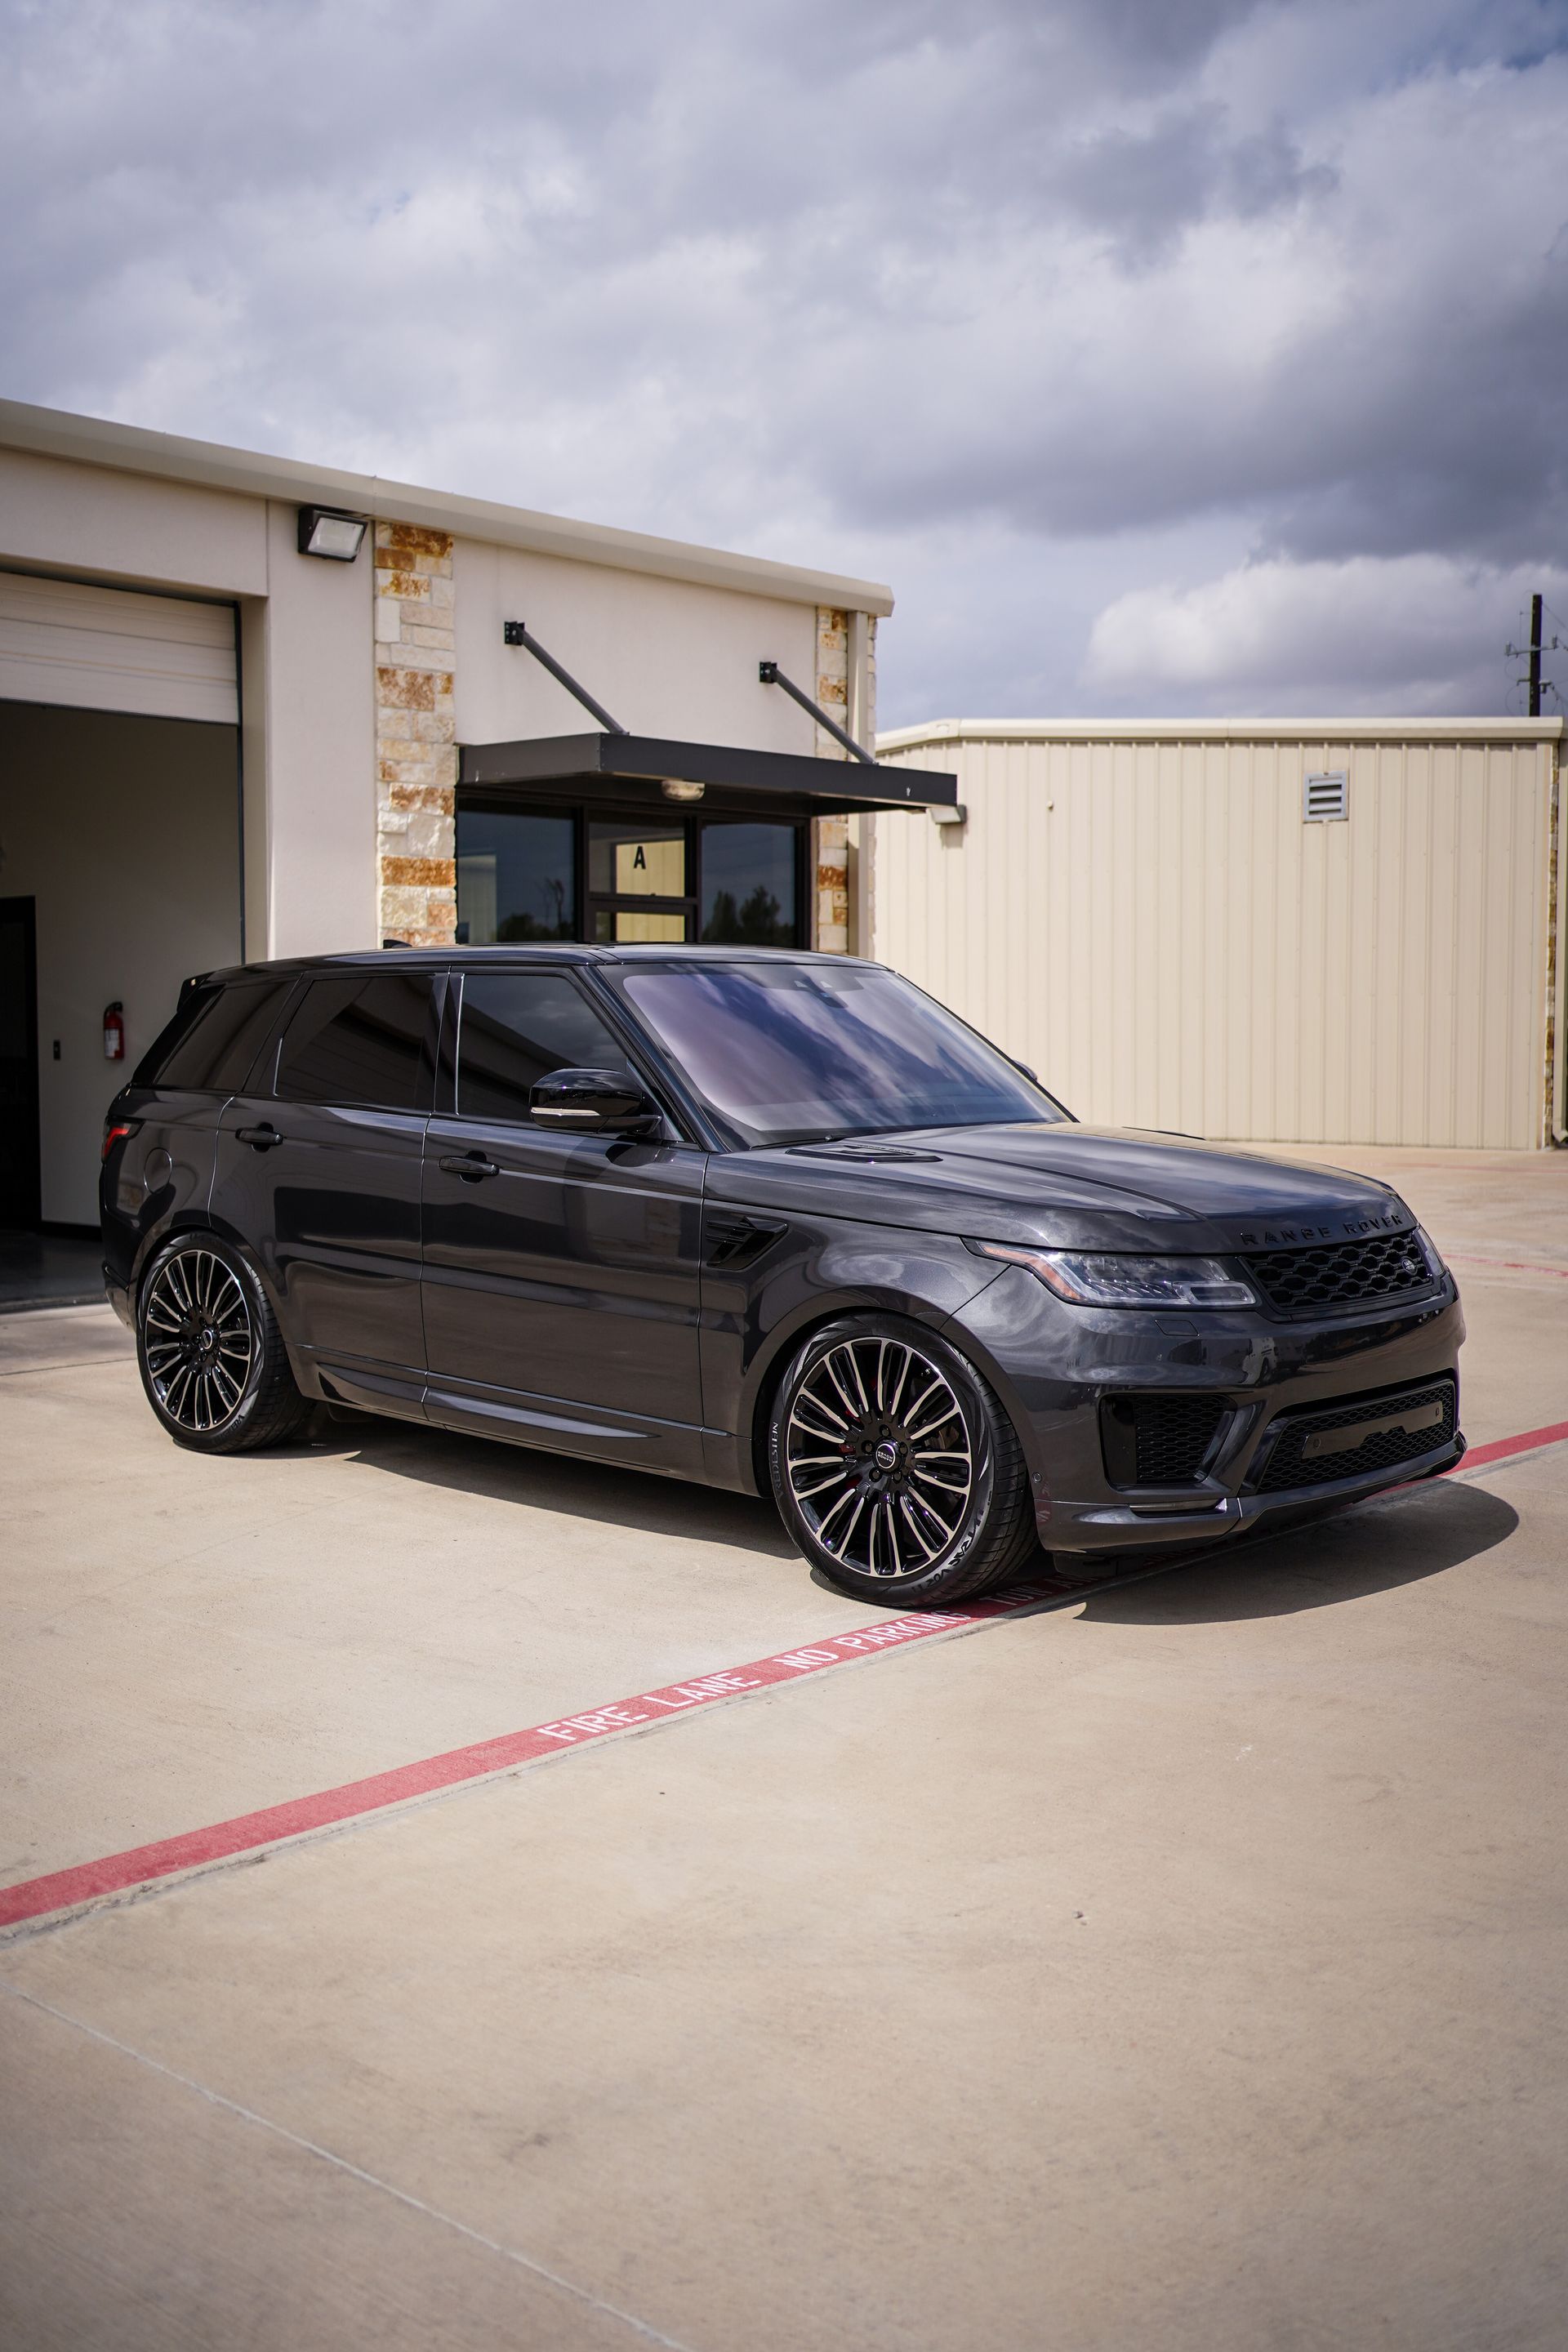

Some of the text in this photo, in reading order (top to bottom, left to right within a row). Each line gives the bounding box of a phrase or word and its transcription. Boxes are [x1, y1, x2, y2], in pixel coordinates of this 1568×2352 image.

[633, 845, 647, 870] A
[1241, 1214, 1404, 1246] RANGE ROVER
[771, 1421, 785, 1499] VREDESTEIN
[537, 1706, 649, 1741] FIRE
[643, 1673, 762, 1708] LANE
[772, 1648, 840, 1669] NO
[831, 1610, 972, 1650] PARKING
